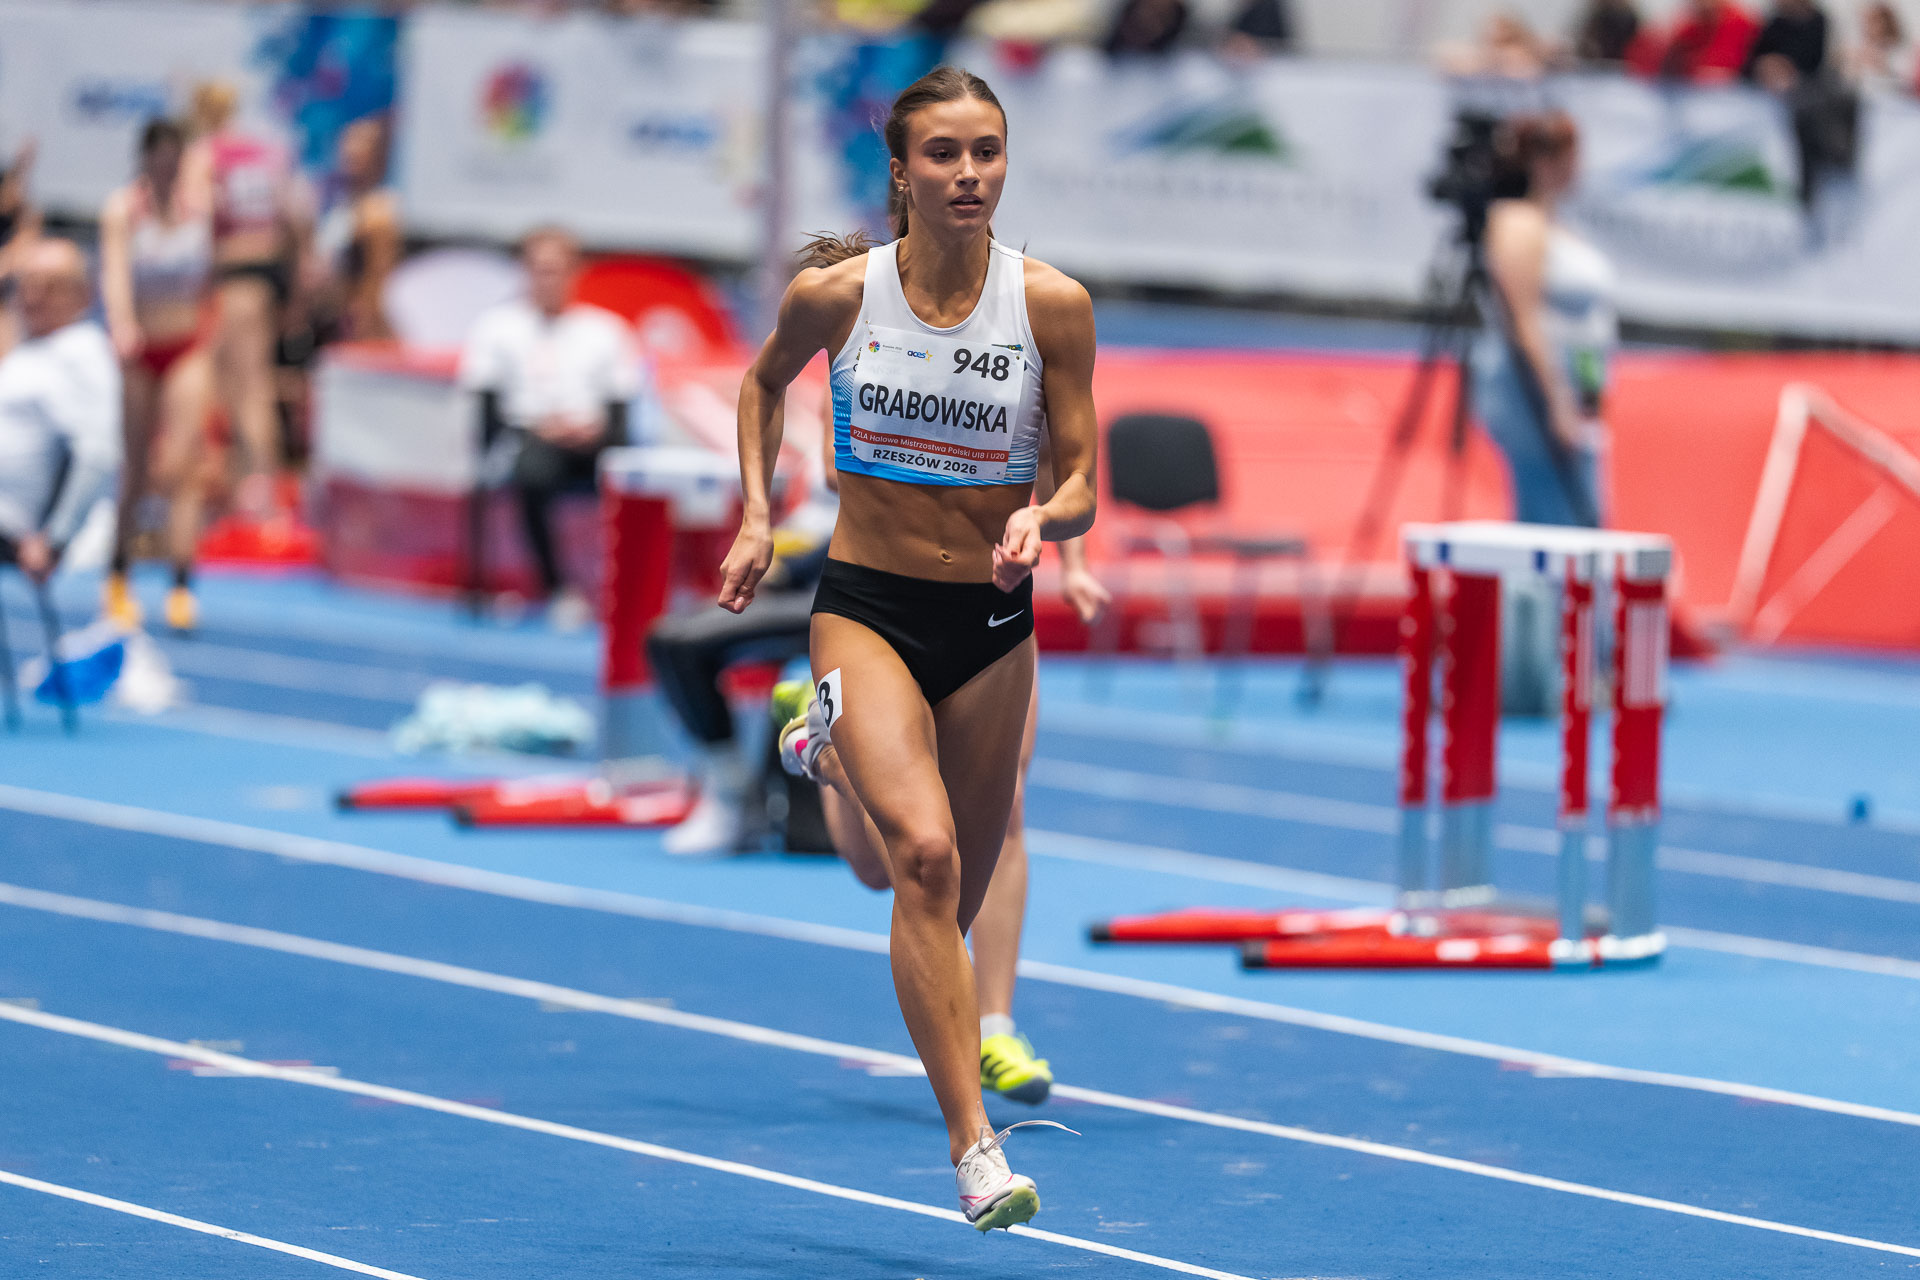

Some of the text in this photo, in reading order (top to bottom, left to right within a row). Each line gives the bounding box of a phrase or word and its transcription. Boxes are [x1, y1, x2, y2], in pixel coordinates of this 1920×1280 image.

[953, 348, 1010, 381] 948
[858, 383, 1008, 433] GRABOWSKA
[853, 429, 868, 440] PZLA
[870, 434, 899, 444] Halowe
[900, 439, 947, 453] Mistrzostwa
[948, 446, 970, 457] Polski
[972, 451, 985, 459] U18
[873, 449, 978, 475] RZESZÓW 2026
[818, 681, 834, 728] 3
